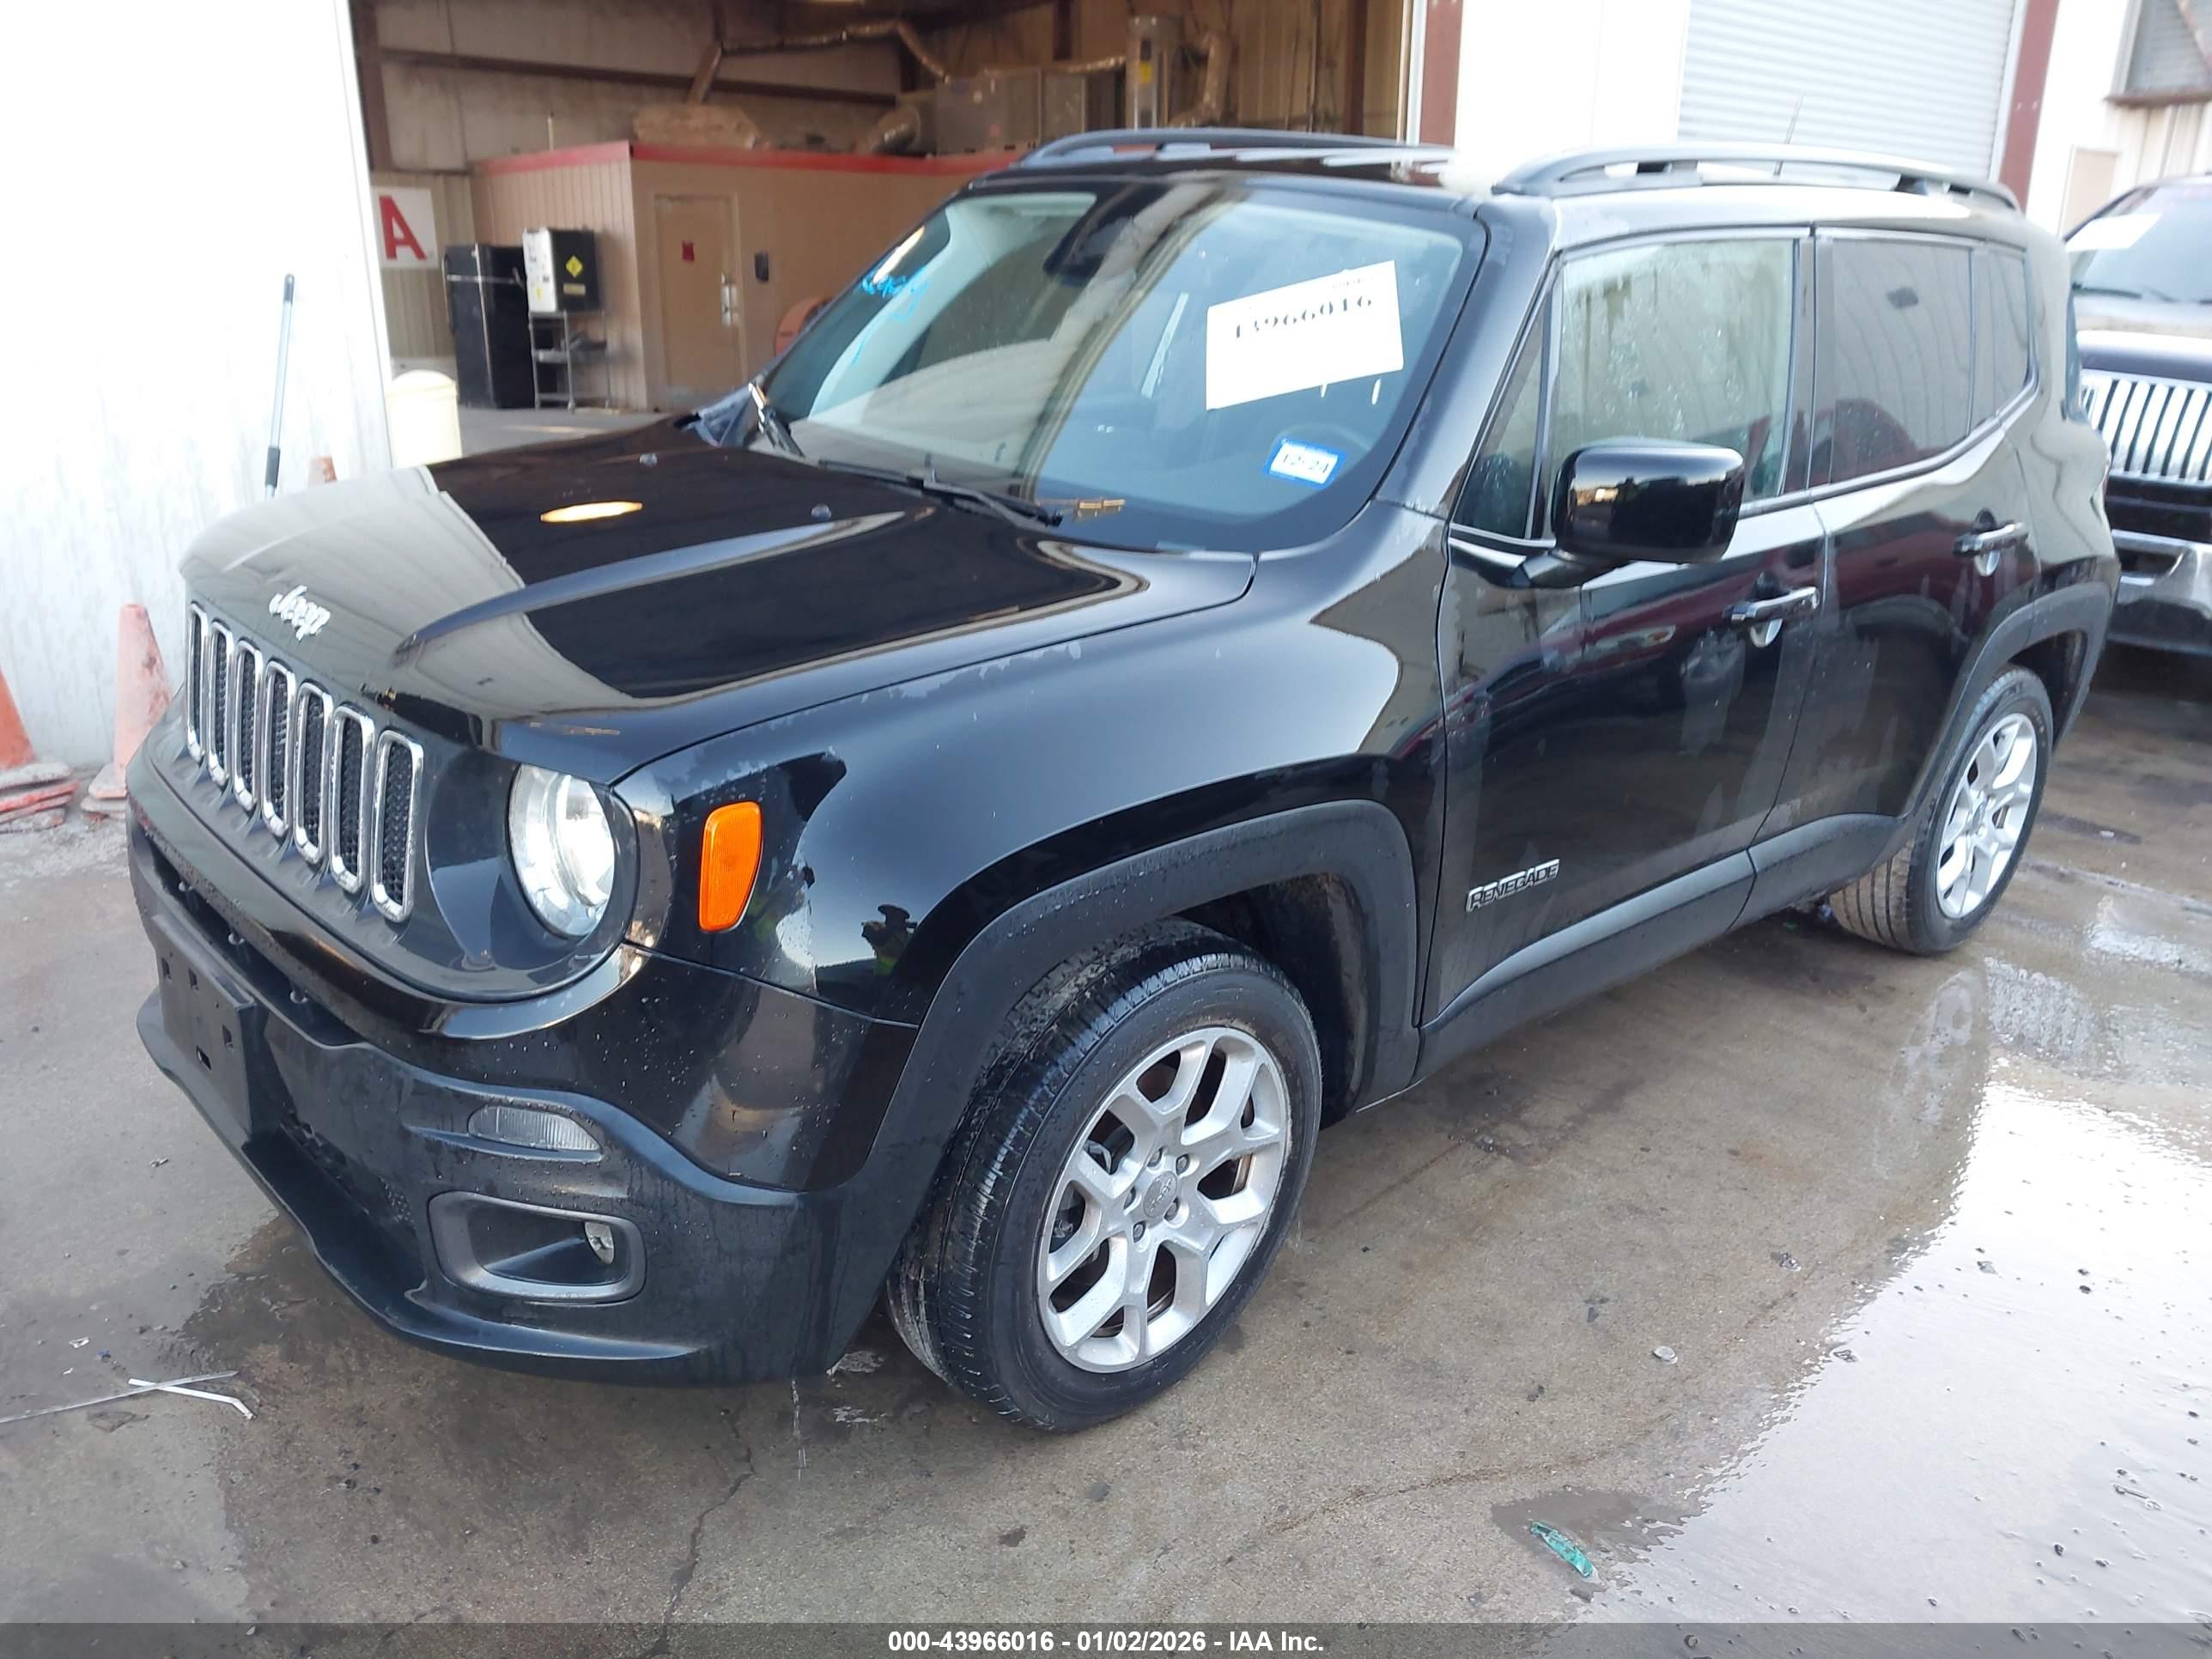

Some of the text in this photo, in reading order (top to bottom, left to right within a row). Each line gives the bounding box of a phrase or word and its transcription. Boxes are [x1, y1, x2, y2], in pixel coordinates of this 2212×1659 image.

[379, 195, 428, 261] A
[268, 585, 331, 641] Jeep
[1465, 859, 1560, 913] RENEGADE
